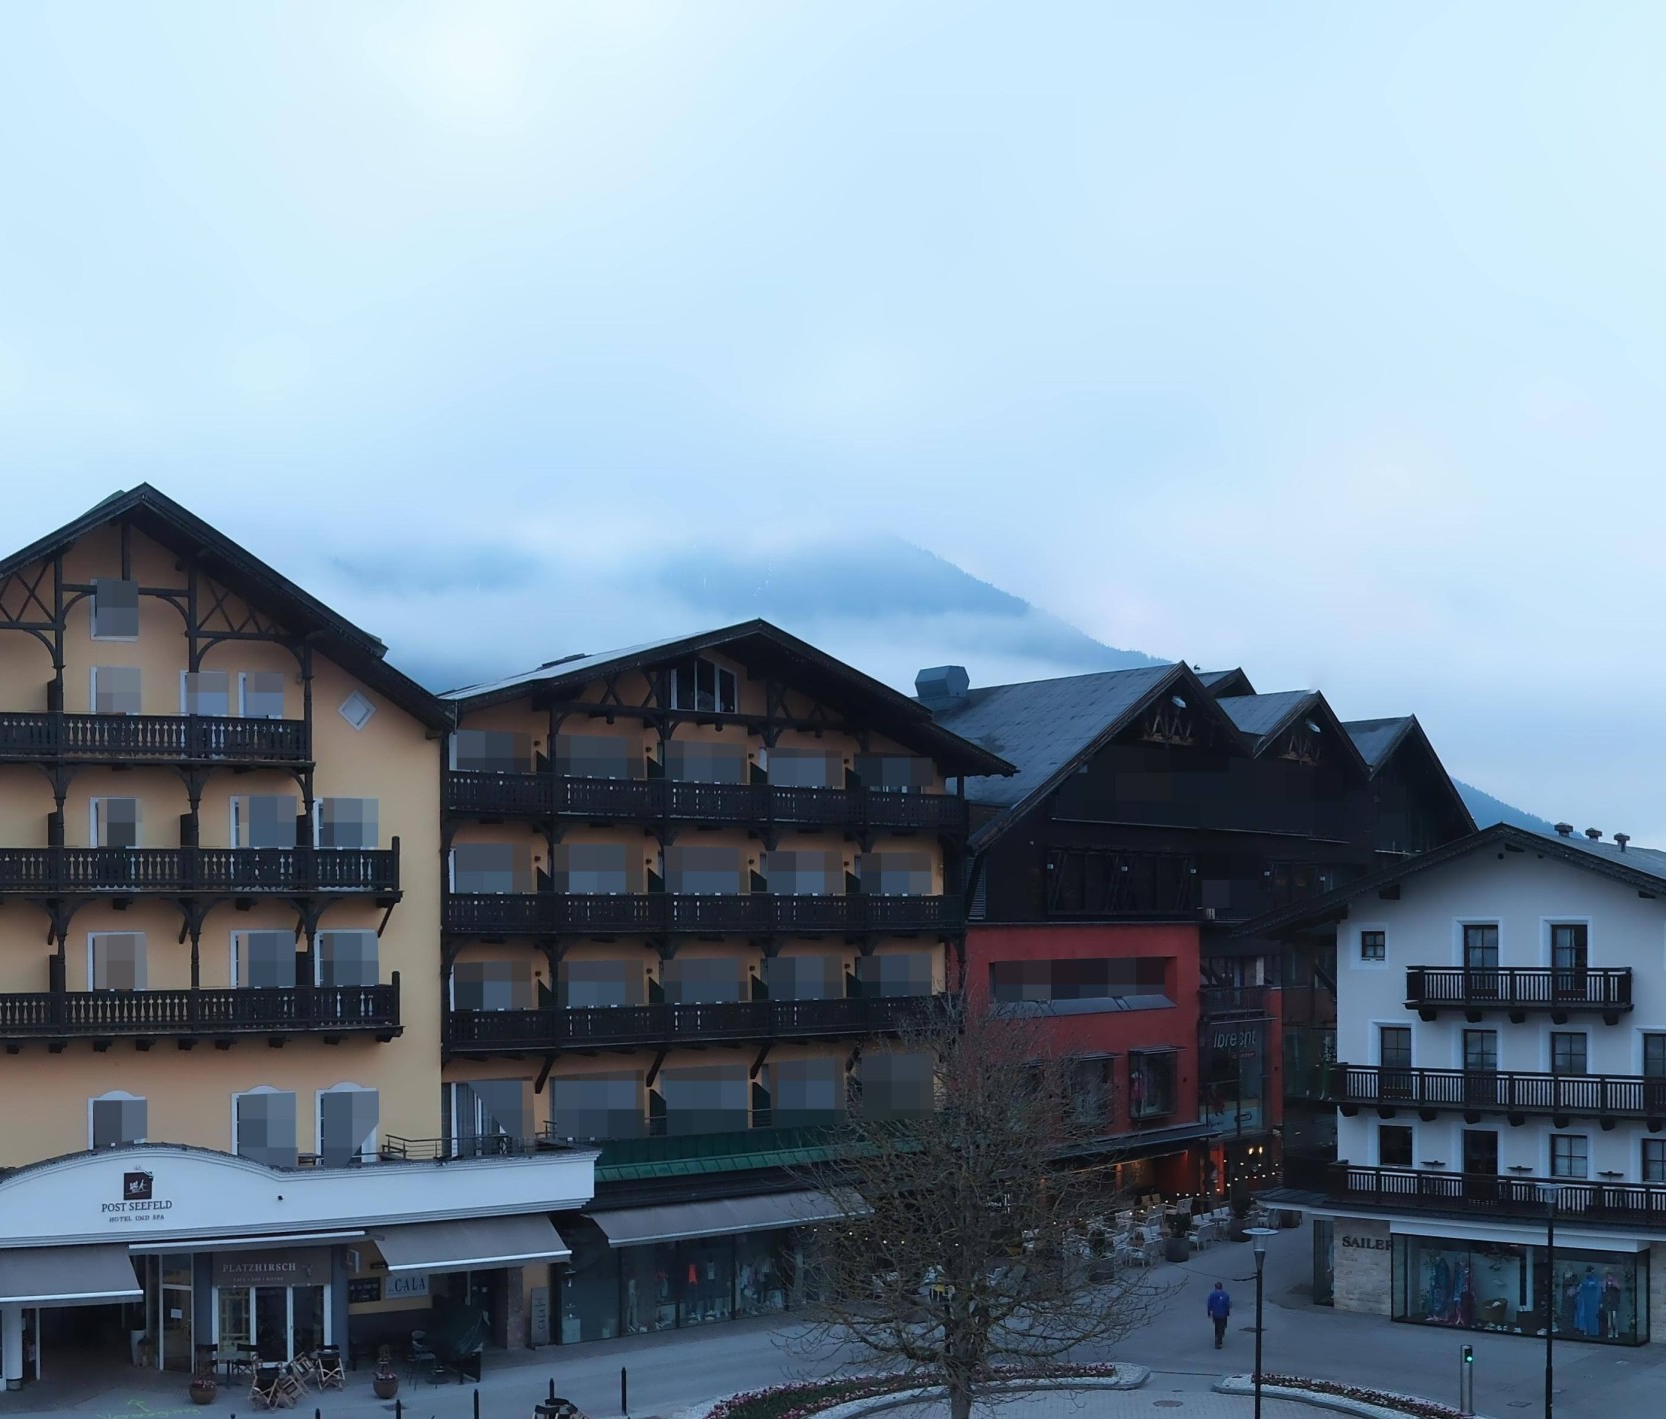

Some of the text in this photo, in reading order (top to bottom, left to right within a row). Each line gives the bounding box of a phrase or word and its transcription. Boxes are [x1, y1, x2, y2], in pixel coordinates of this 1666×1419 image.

[101, 1200, 172, 1213] POST SEEFELD
[222, 1262, 296, 1273] PLATZHIRSCH
